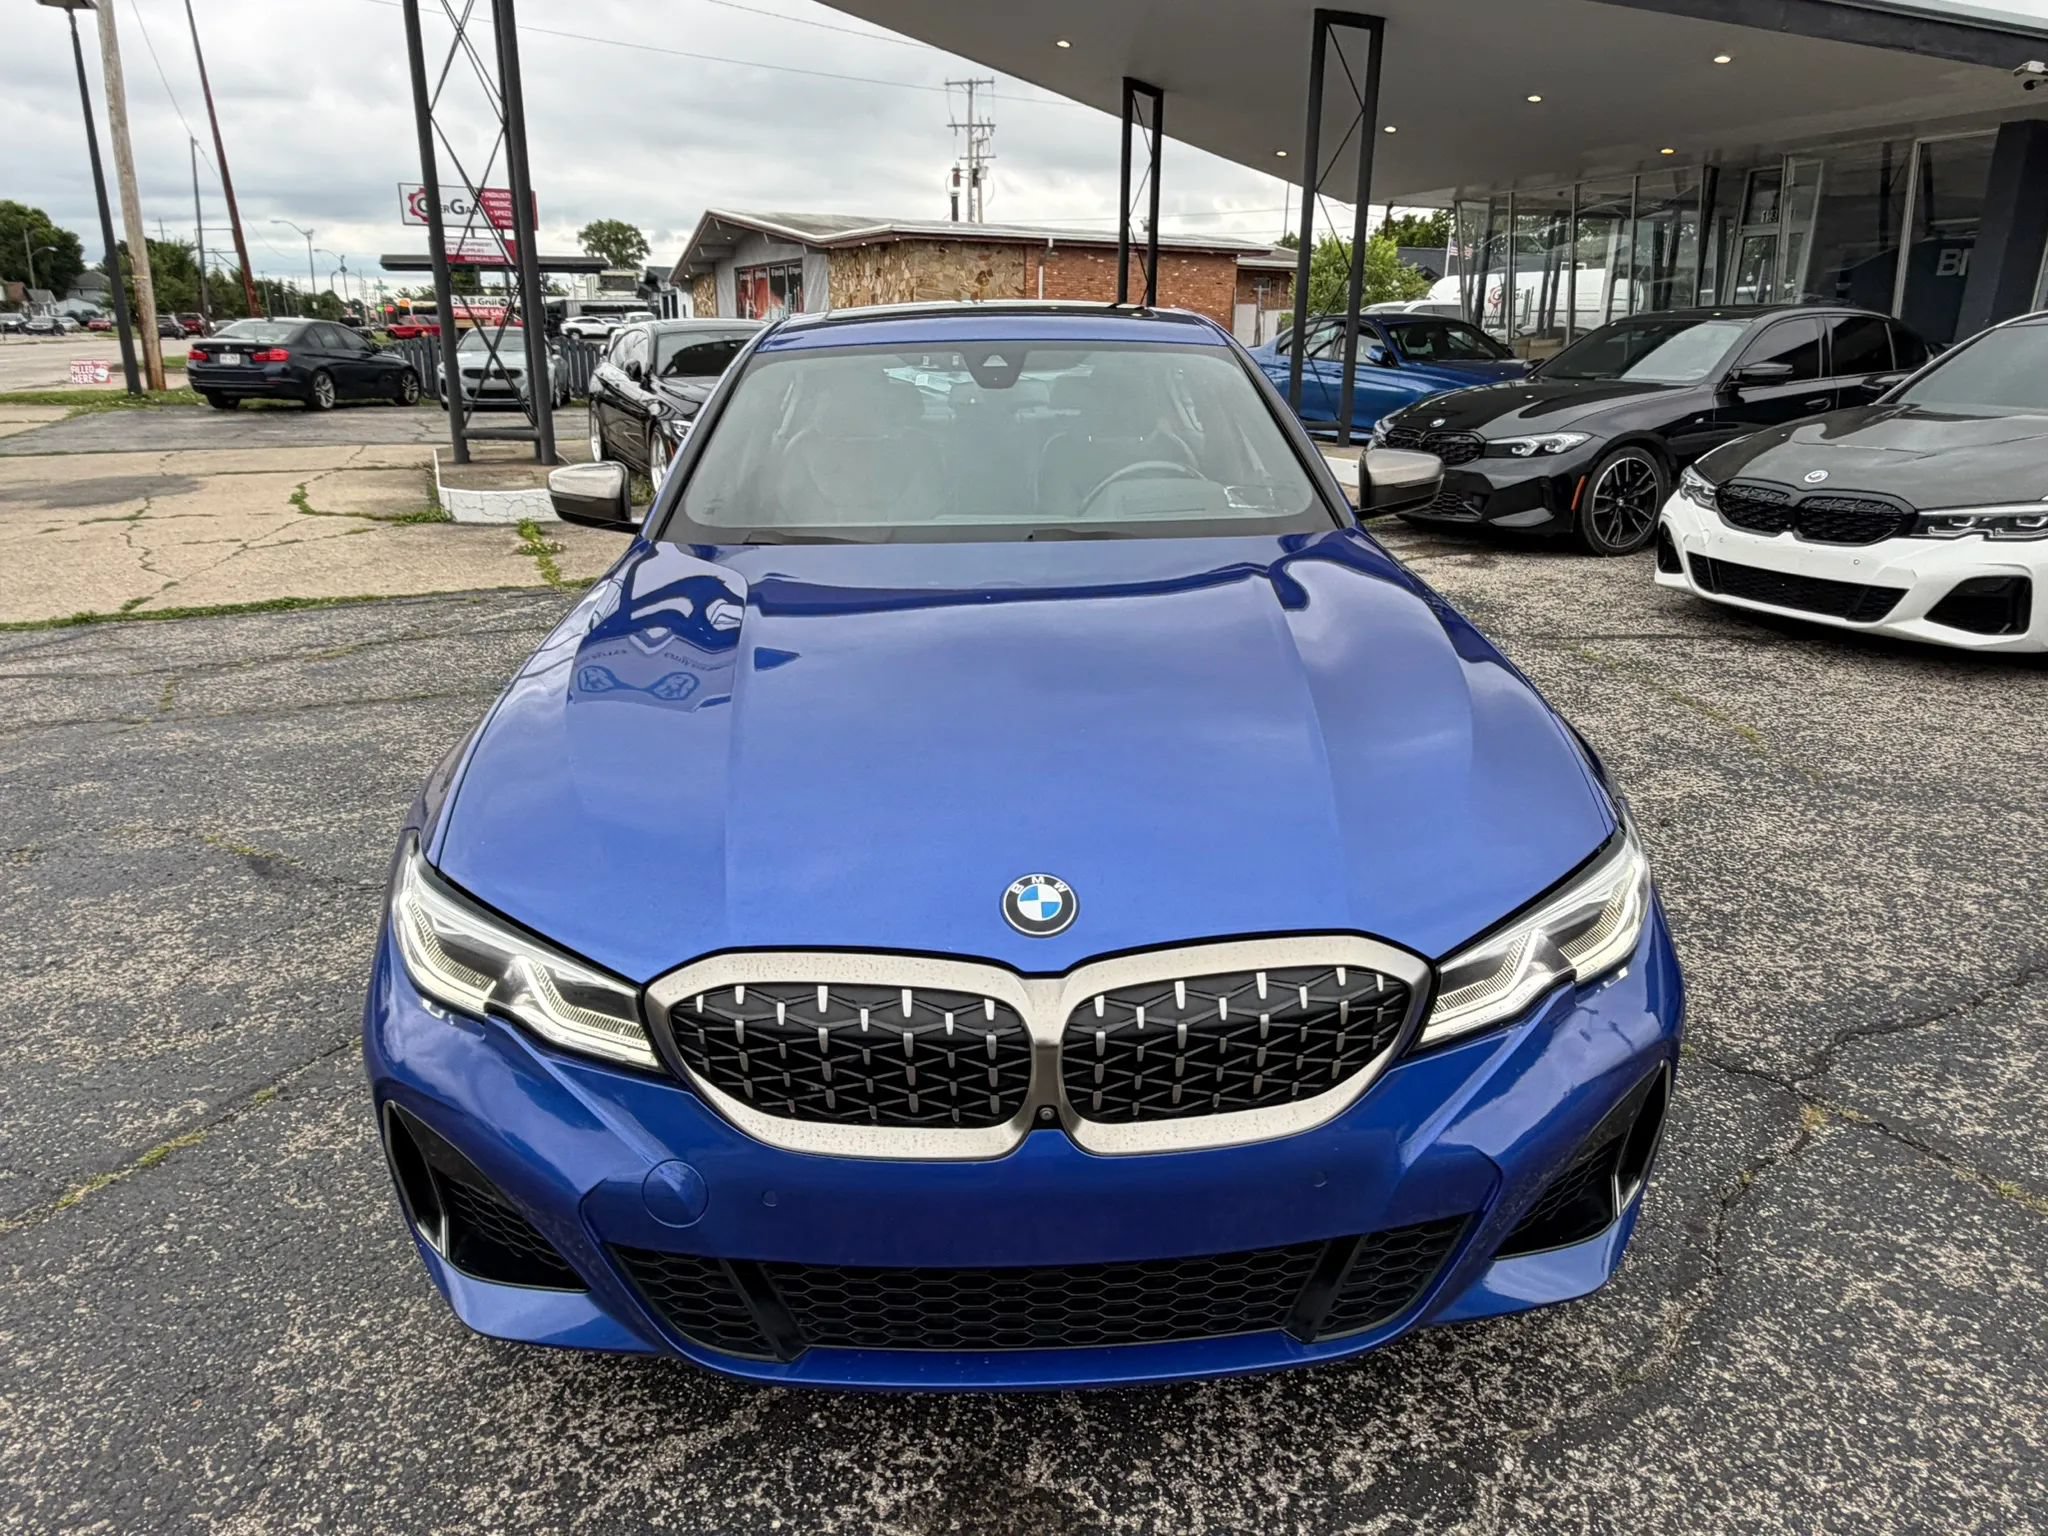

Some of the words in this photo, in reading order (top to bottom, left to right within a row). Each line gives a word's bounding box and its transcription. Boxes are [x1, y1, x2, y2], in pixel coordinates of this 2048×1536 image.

[478, 297, 497, 305] Grill
[71, 365, 95, 374] FILLED
[71, 374, 95, 384] HERE
[1010, 876, 1069, 894] BMW
